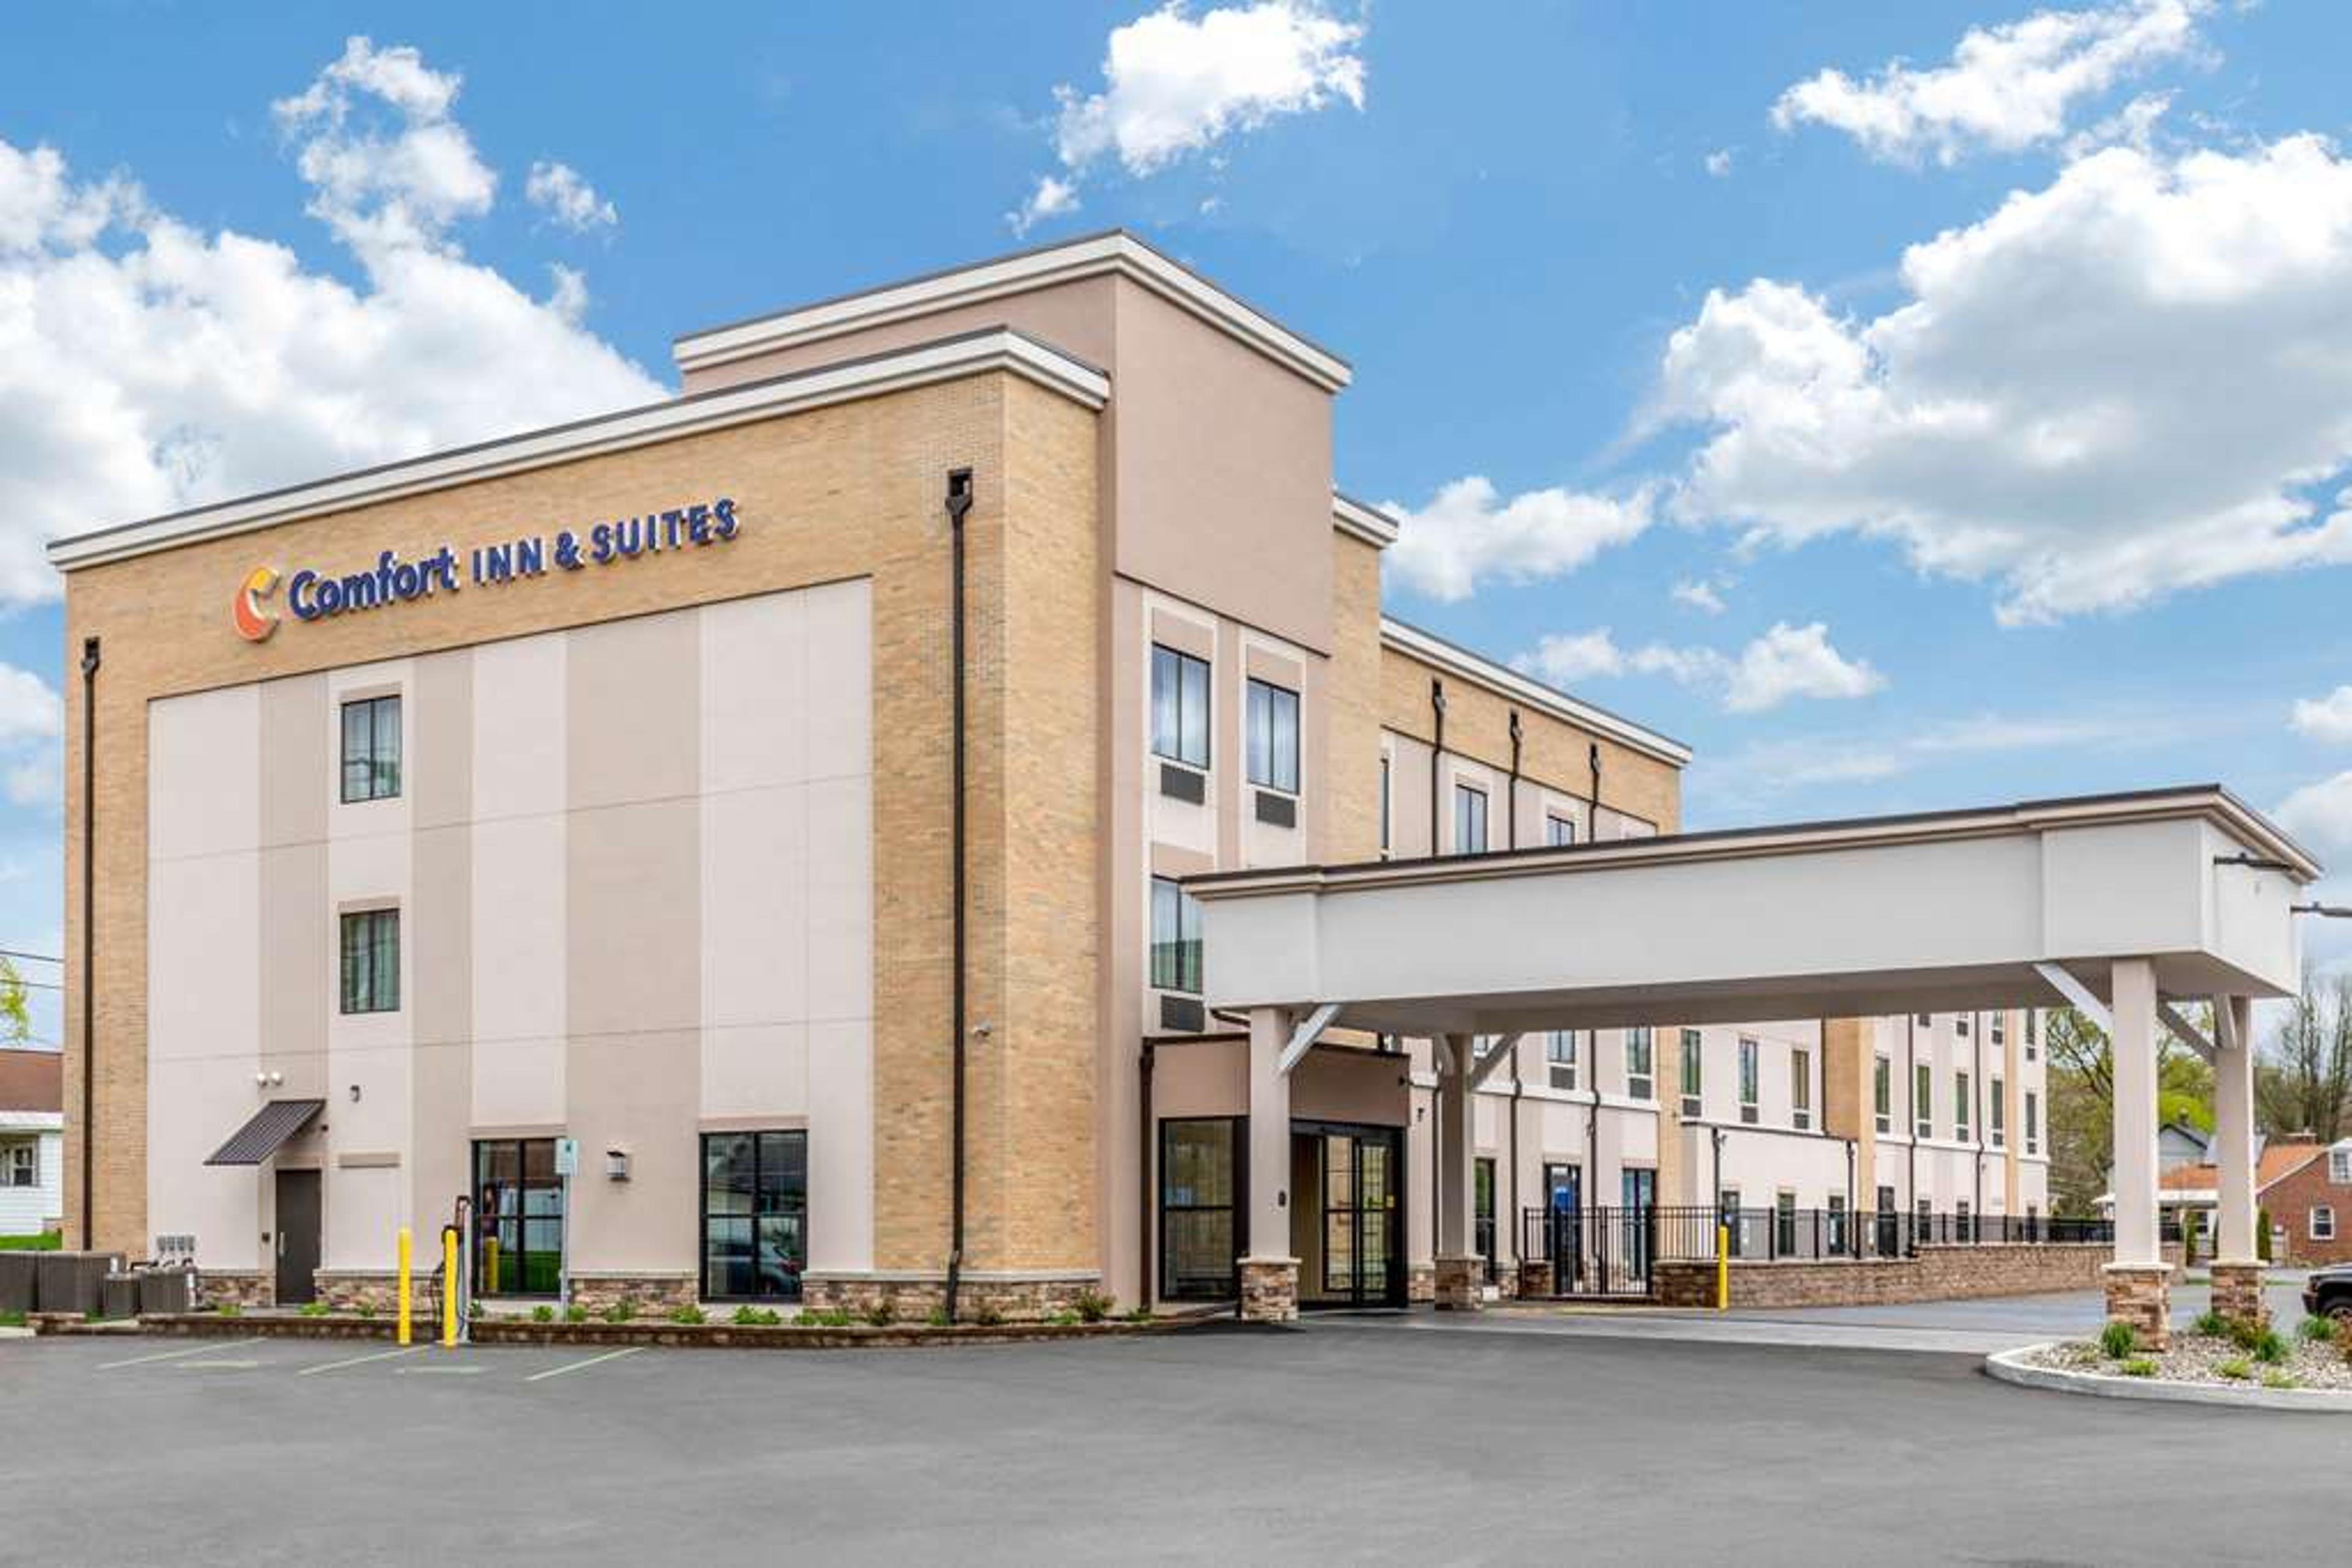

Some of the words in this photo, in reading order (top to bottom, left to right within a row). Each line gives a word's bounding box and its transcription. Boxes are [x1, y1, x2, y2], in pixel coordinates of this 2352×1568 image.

[288, 550, 456, 619] Comfort
[472, 539, 543, 582] INN
[554, 532, 581, 567] &
[591, 498, 737, 561] SUITES
